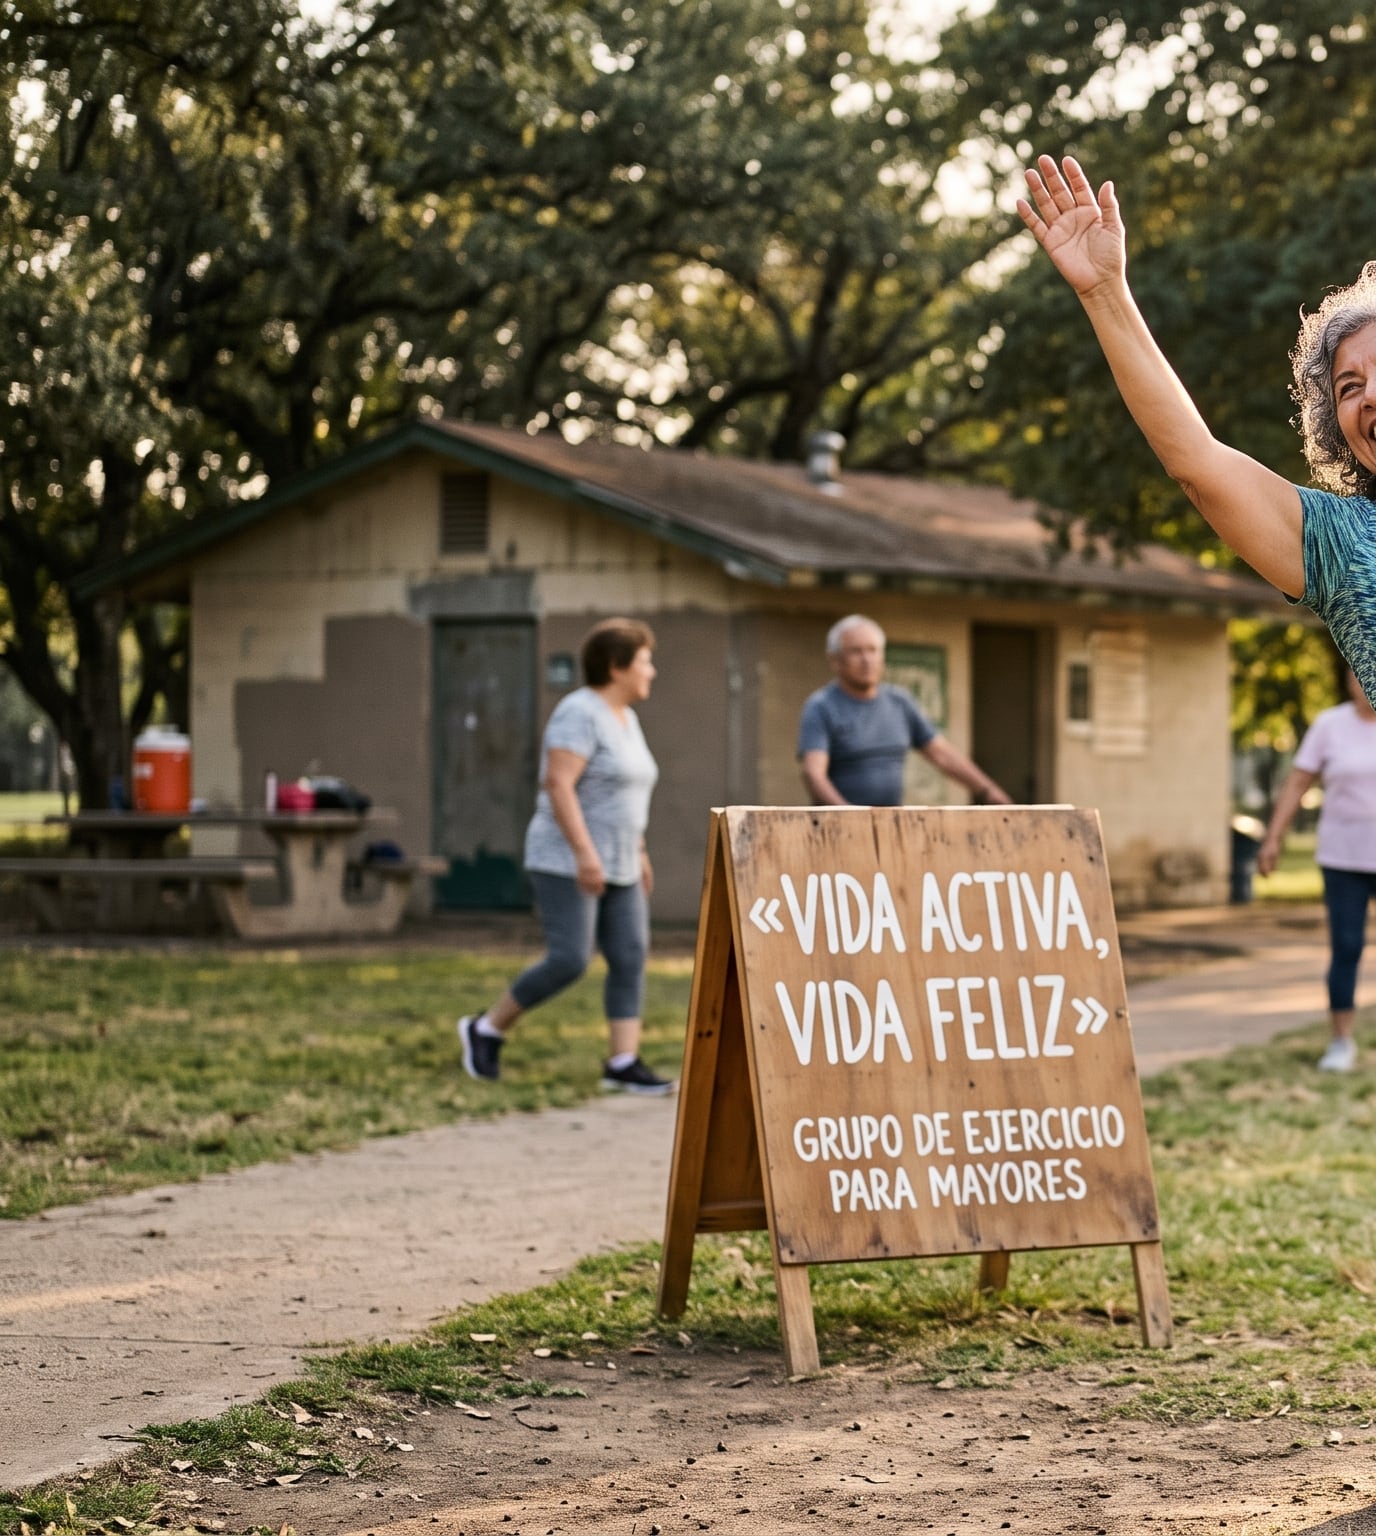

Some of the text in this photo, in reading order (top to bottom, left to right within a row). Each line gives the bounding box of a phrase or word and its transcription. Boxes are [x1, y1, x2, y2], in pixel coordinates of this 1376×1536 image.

[748, 870, 1110, 960] «VIDA ACTIVA,
[774, 973, 1109, 1066] VIDA FELIZ»
[793, 1104, 1126, 1162] GRUPO DE EJERCICIO
[829, 1158, 1088, 1213] PARA MAYORES
